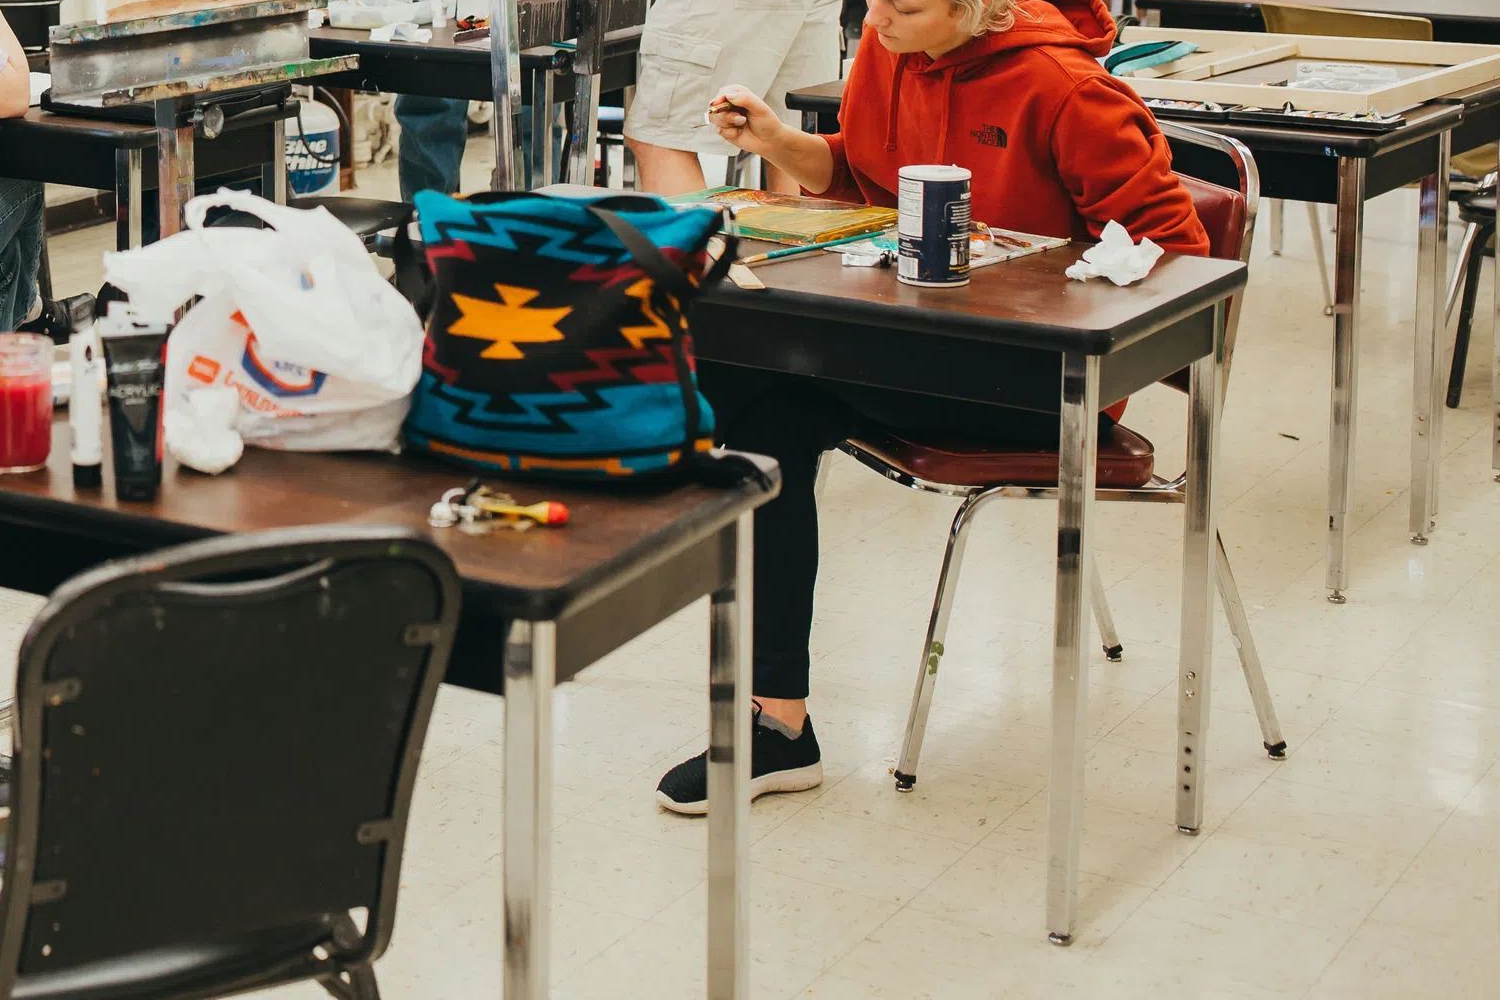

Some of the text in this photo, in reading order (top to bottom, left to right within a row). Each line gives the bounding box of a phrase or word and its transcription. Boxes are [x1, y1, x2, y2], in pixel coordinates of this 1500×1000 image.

[980, 123, 997, 133] THE
[969, 129, 997, 140] NORTH
[977, 136, 998, 147] FACE
